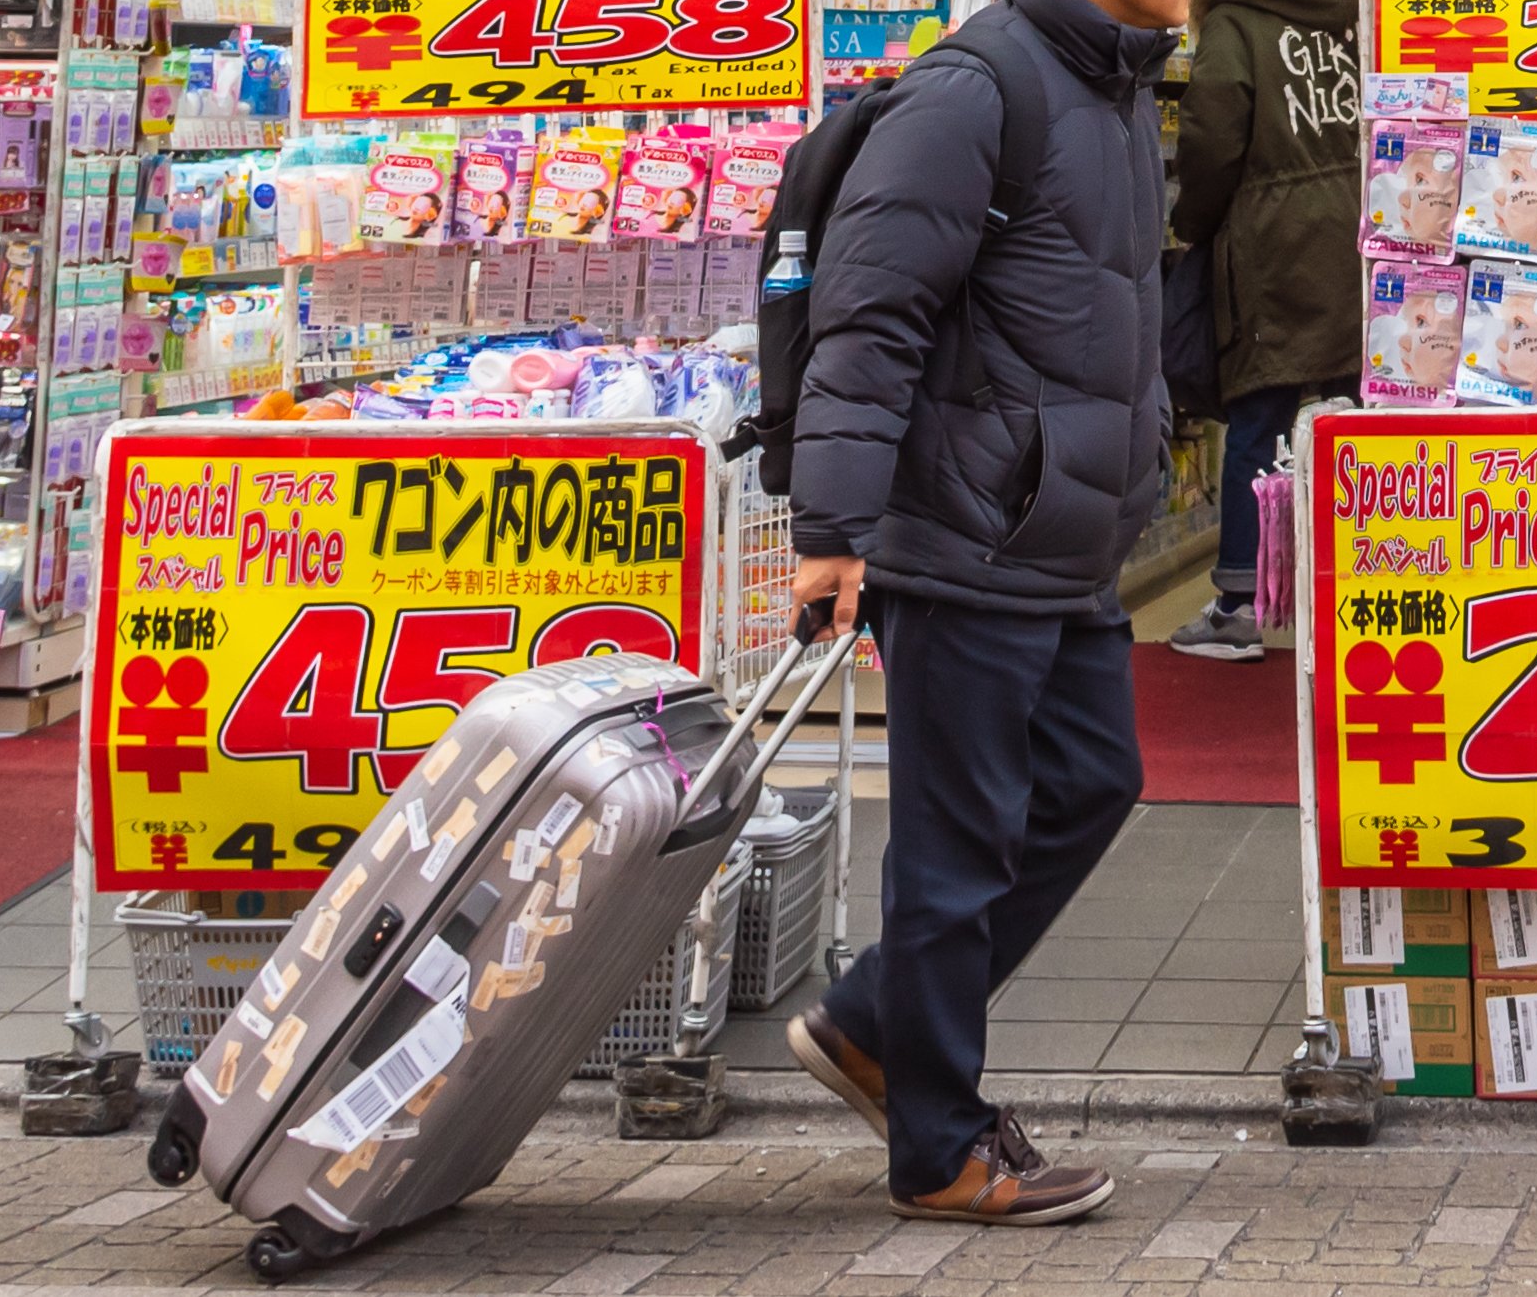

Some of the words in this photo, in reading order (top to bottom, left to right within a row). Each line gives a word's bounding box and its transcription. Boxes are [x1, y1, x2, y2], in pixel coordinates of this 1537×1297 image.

[401, 80, 595, 105] 494
[1367, 383, 1438, 400] BABYISH
[122, 462, 241, 547] Special
[1334, 440, 1458, 530] Special
[350, 453, 687, 568] ワゴン内の商品
[236, 511, 346, 587] Price
[1352, 535, 1451, 576] スペシャル
[135, 554, 224, 593] スペシャル
[370, 569, 674, 595] クーポン等割引き対象外となります
[213, 822, 360, 870] 49
